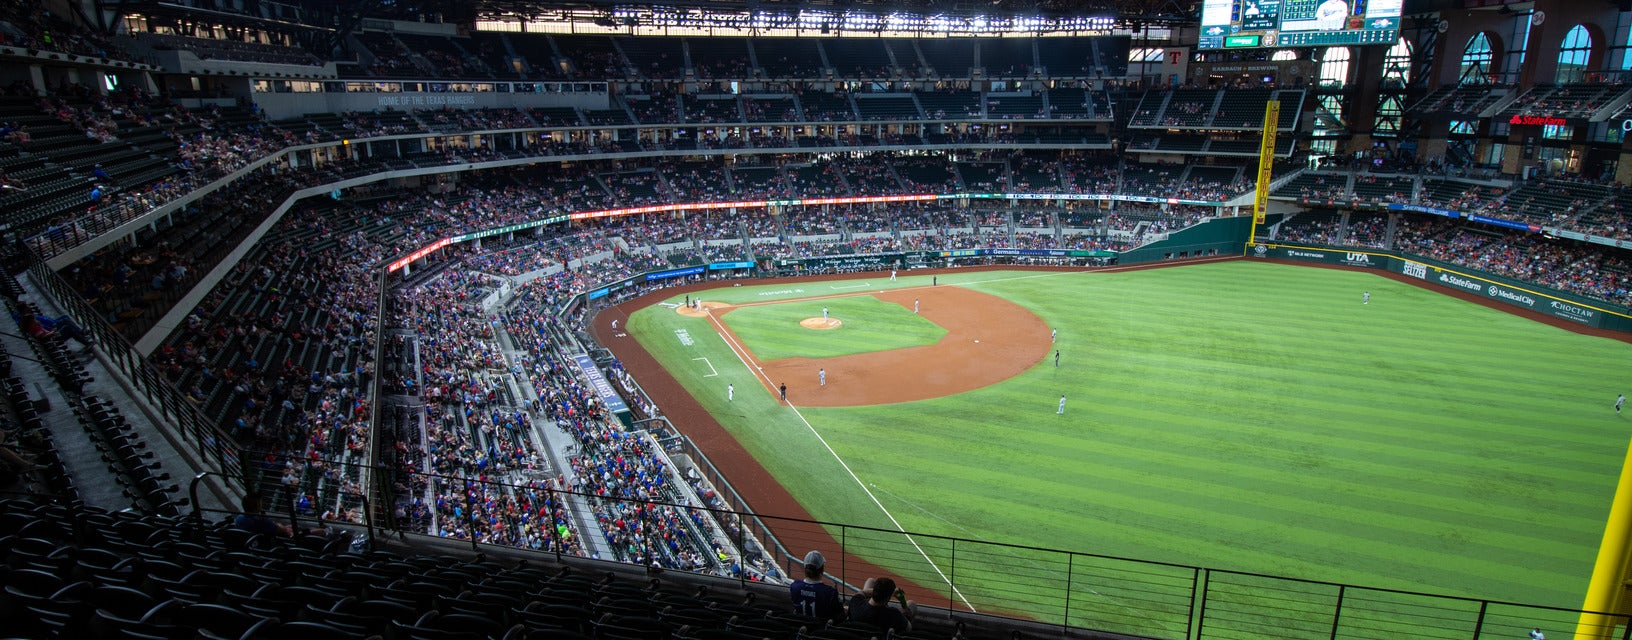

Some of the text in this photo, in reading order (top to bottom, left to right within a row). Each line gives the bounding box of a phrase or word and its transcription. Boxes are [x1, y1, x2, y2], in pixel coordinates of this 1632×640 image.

[1169, 51, 1182, 64] T
[378, 95, 475, 106] HOME OF THE TEXAS RANGERS
[1346, 252, 1370, 262] UTA
[1402, 264, 1427, 280] SELTZER
[1554, 302, 1594, 317] CHOCTAW
[800, 599, 816, 617] 11
